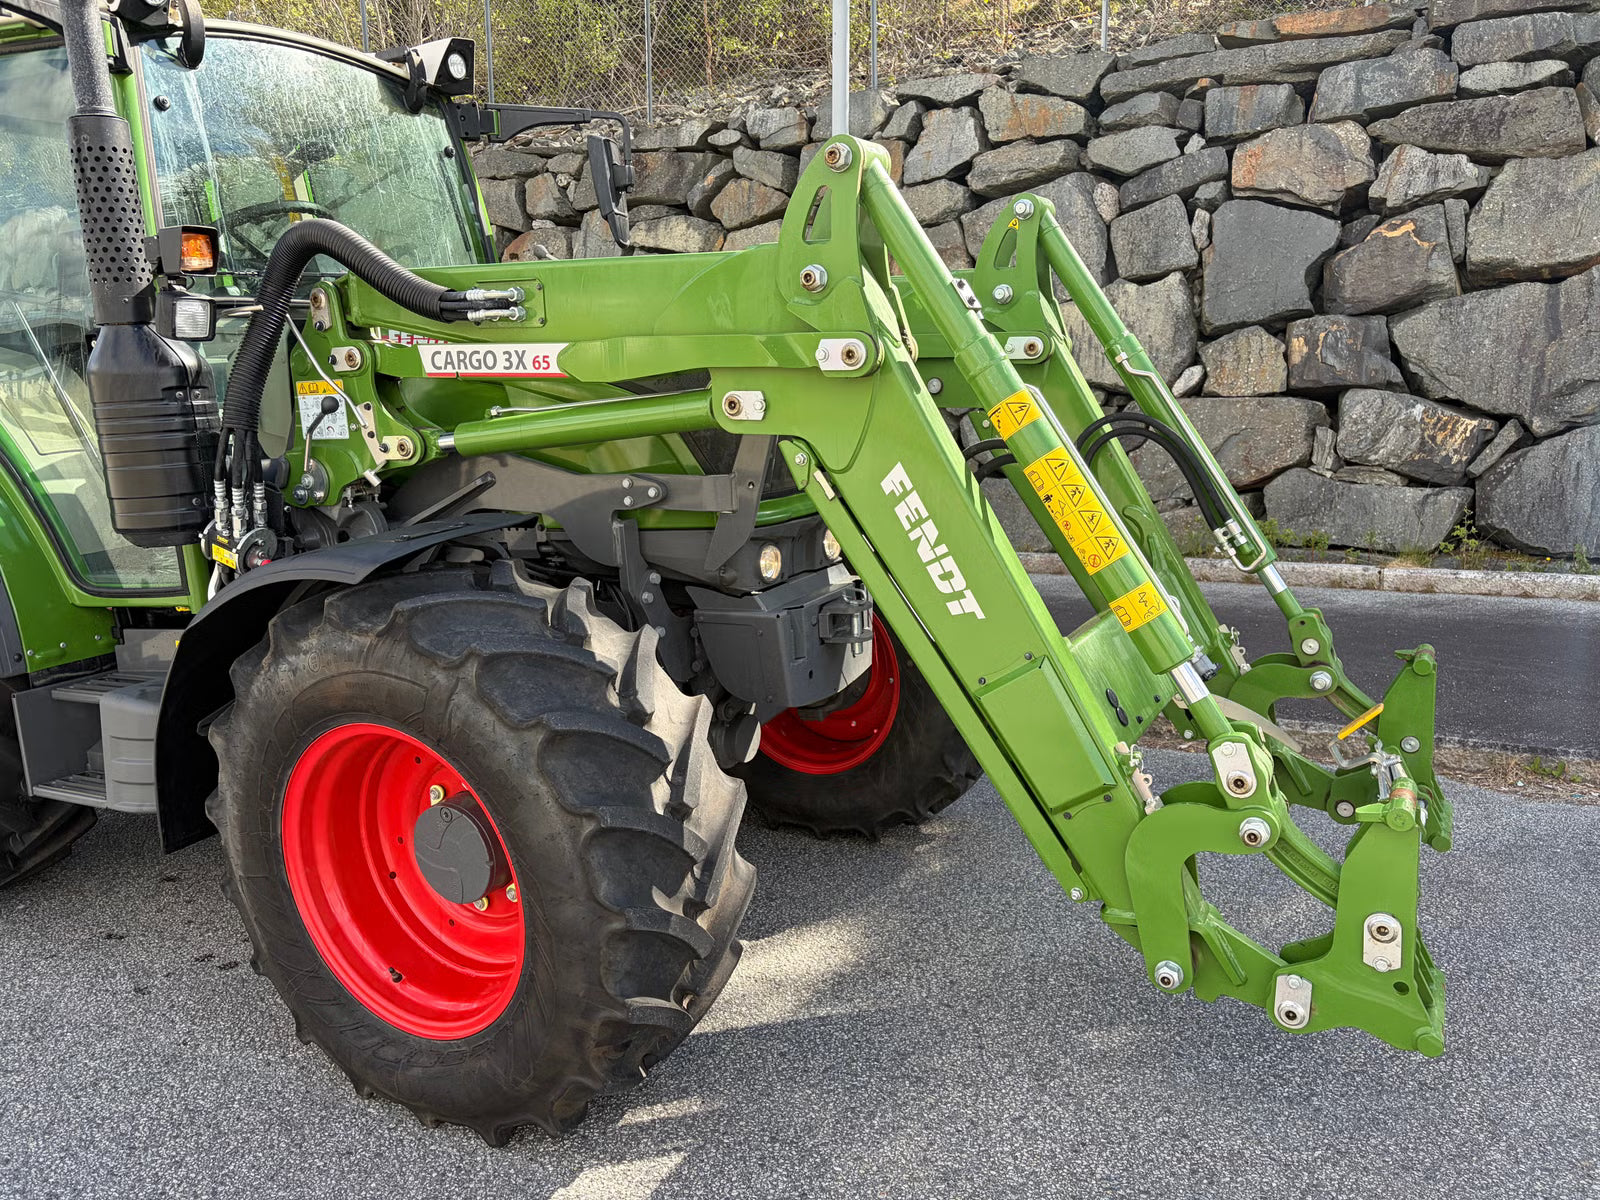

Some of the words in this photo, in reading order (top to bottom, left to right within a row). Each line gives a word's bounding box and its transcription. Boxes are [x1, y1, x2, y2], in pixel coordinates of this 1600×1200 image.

[430, 350, 498, 371] CARGO
[503, 349, 527, 371] 3X
[532, 355, 551, 371] 65
[880, 461, 986, 619] FENDT
